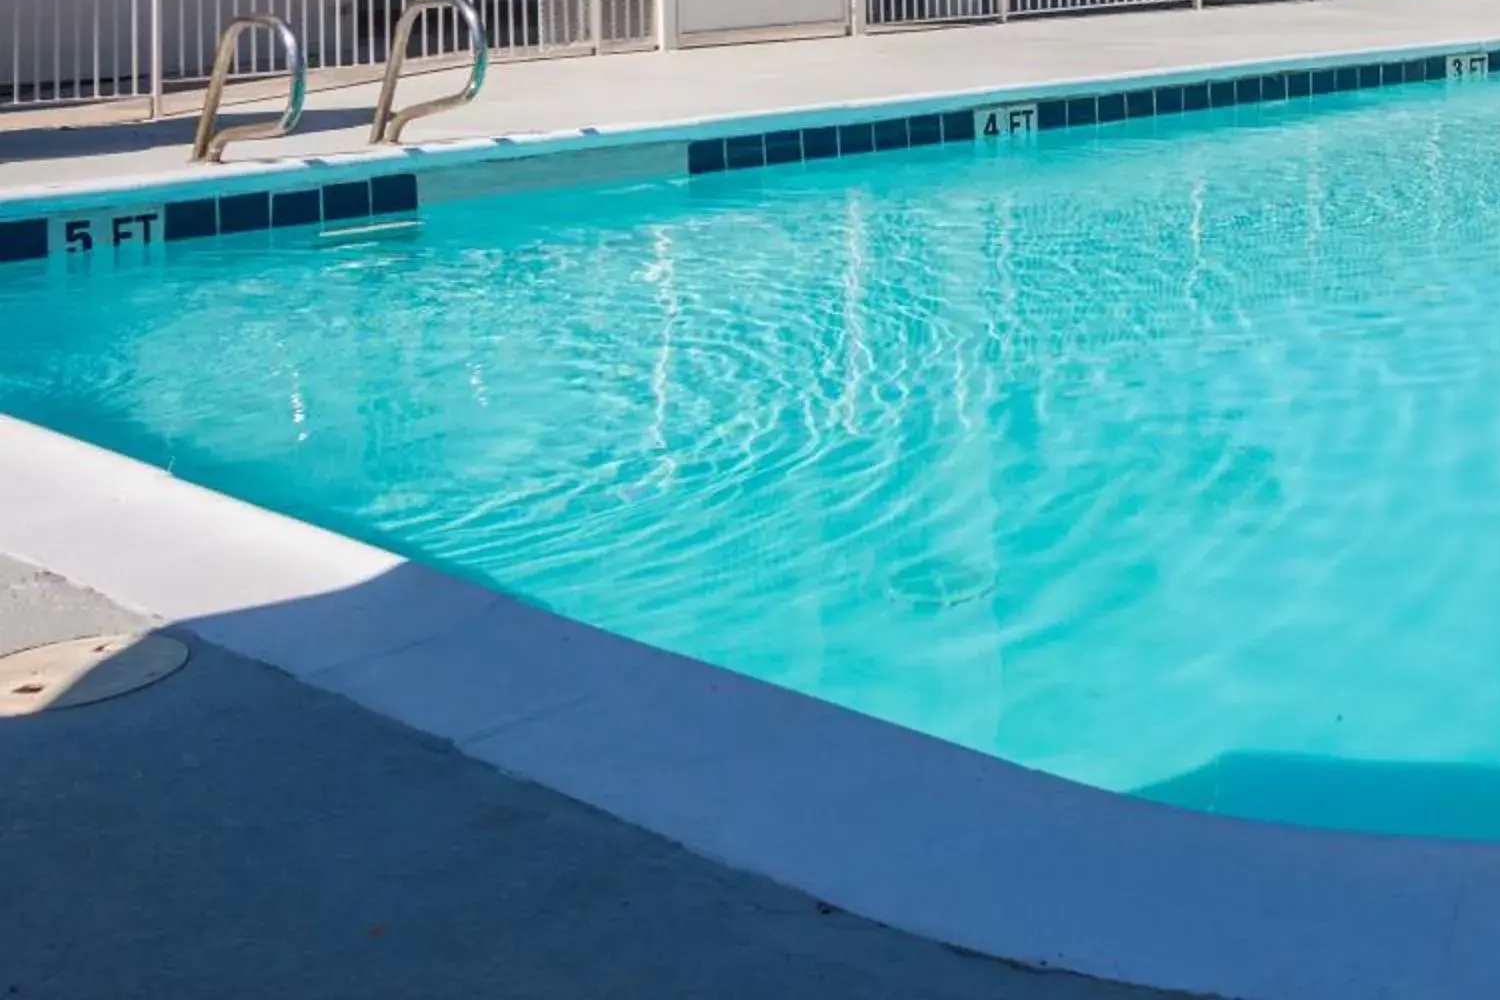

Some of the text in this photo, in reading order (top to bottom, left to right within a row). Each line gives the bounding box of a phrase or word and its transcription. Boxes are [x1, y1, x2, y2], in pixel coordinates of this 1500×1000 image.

[984, 109, 1034, 135] 4 FT
[65, 213, 159, 252] 5 FT
